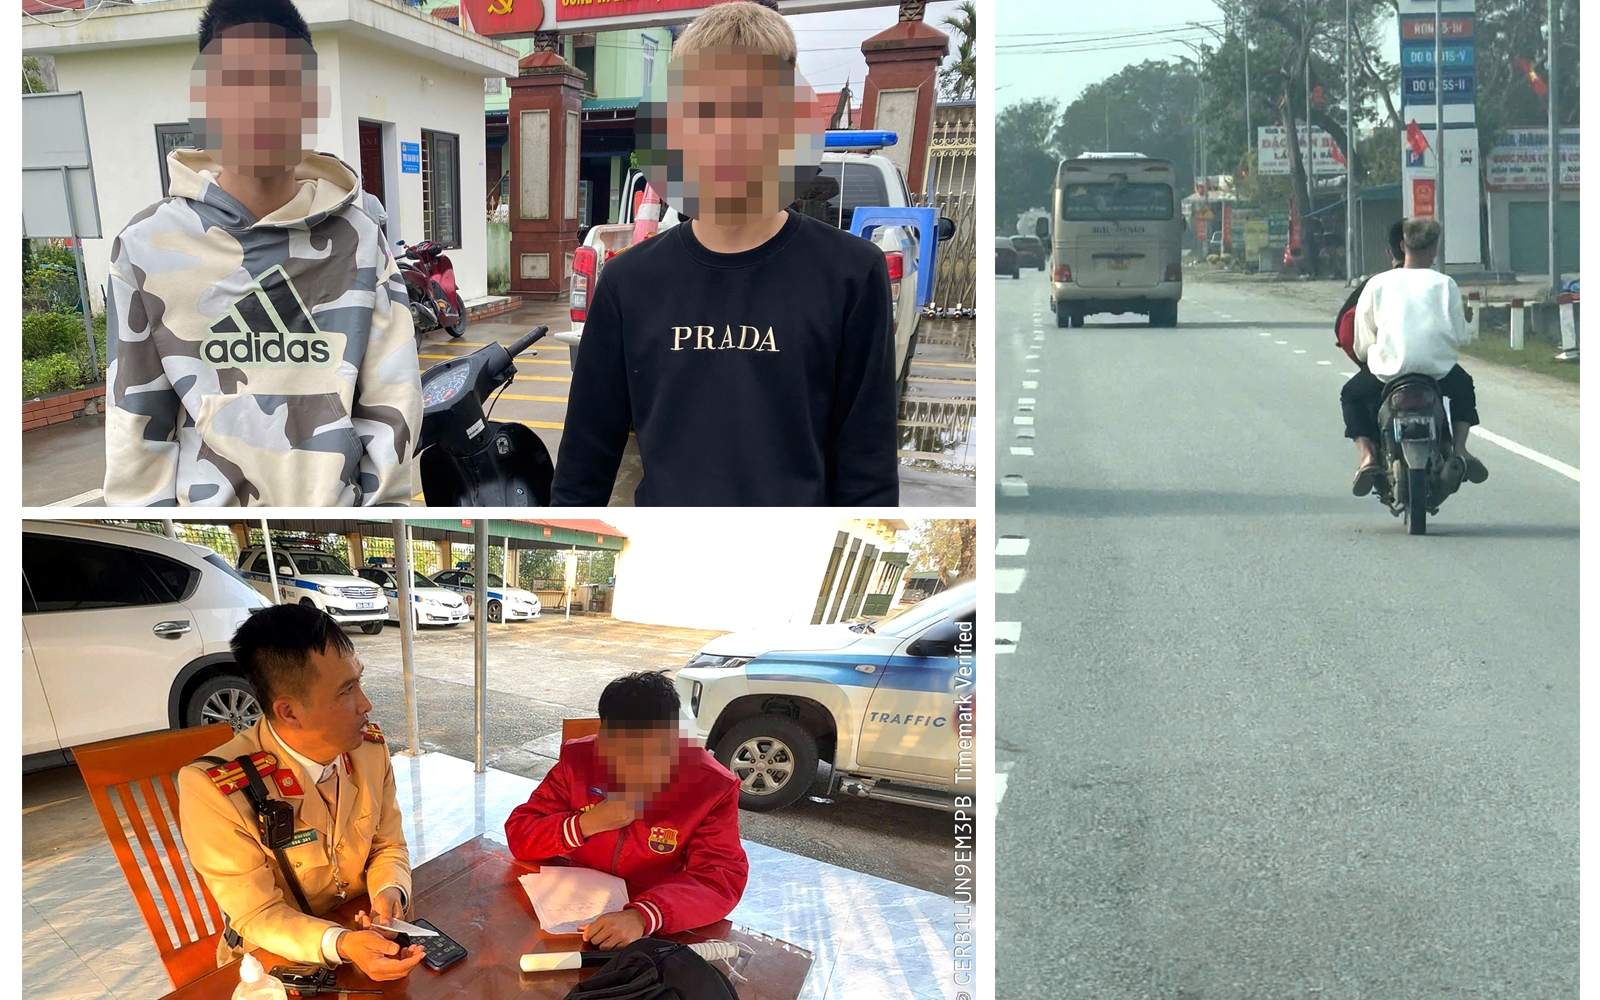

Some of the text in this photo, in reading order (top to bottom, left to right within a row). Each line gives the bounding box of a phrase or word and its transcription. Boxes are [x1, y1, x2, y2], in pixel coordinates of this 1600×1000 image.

[1410, 52, 1423, 62] DO
[1412, 80, 1426, 91] DO
[670, 324, 780, 352] PRADA
[204, 332, 330, 363] adidas
[870, 712, 947, 728] TRAFFIC
